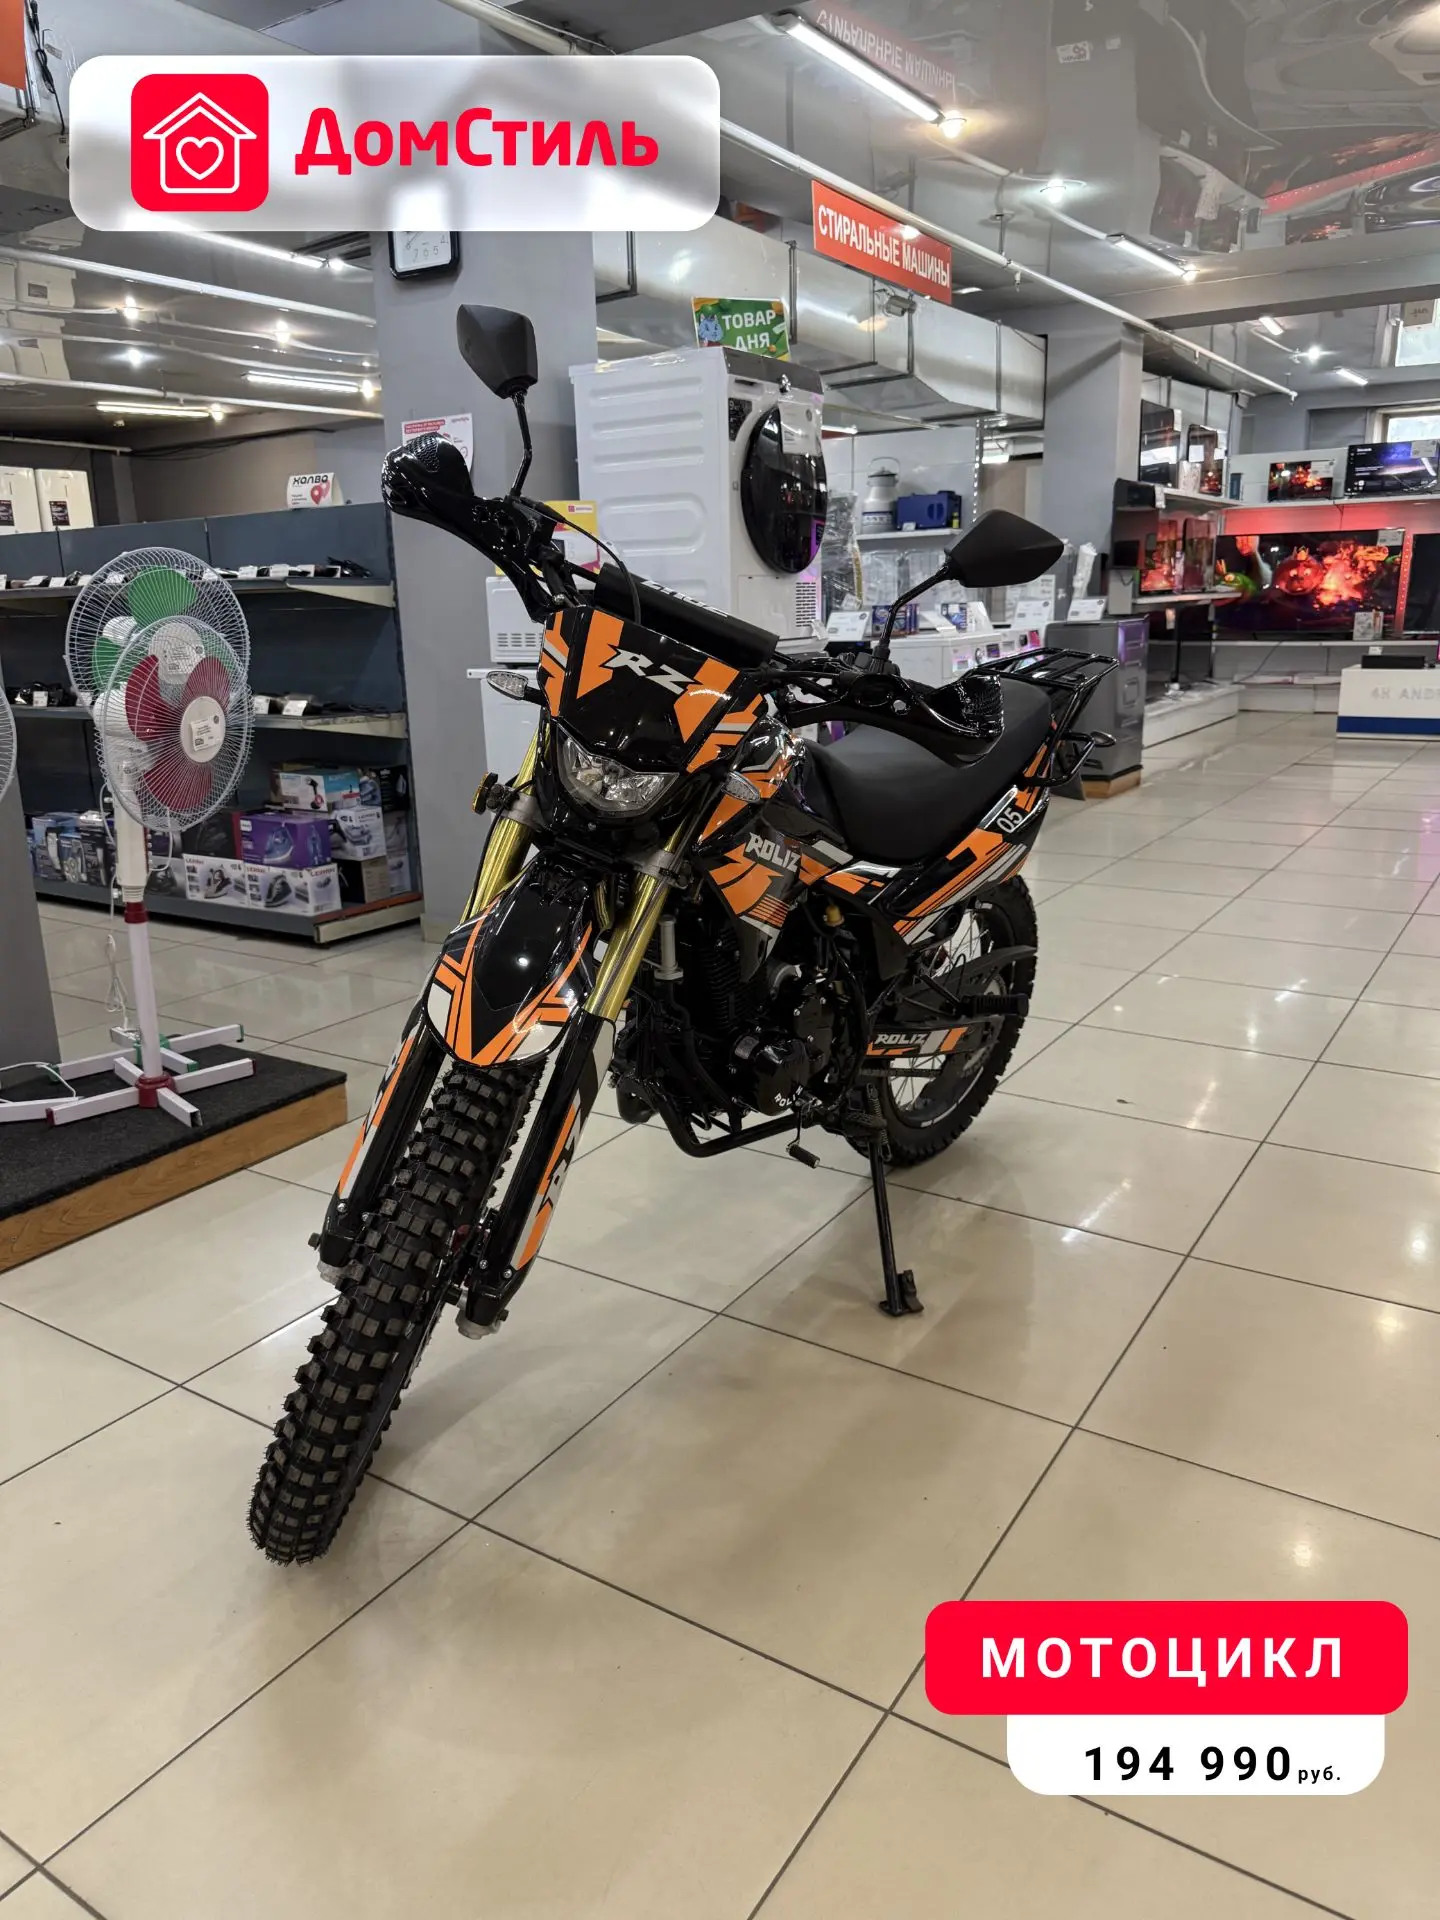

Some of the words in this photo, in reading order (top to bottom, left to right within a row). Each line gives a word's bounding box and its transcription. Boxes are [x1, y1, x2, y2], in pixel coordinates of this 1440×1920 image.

[818, 204, 901, 268] СТИРАЛЬНЫЕ
[902, 240, 950, 289] МАШИНЫ
[721, 309, 776, 330] ТОВАР
[735, 332, 770, 352] ДНЯ
[604, 648, 695, 695] RZ
[996, 807, 1023, 833] 05
[745, 832, 801, 872] ROLIZ
[874, 1033, 928, 1045] ROLIZ
